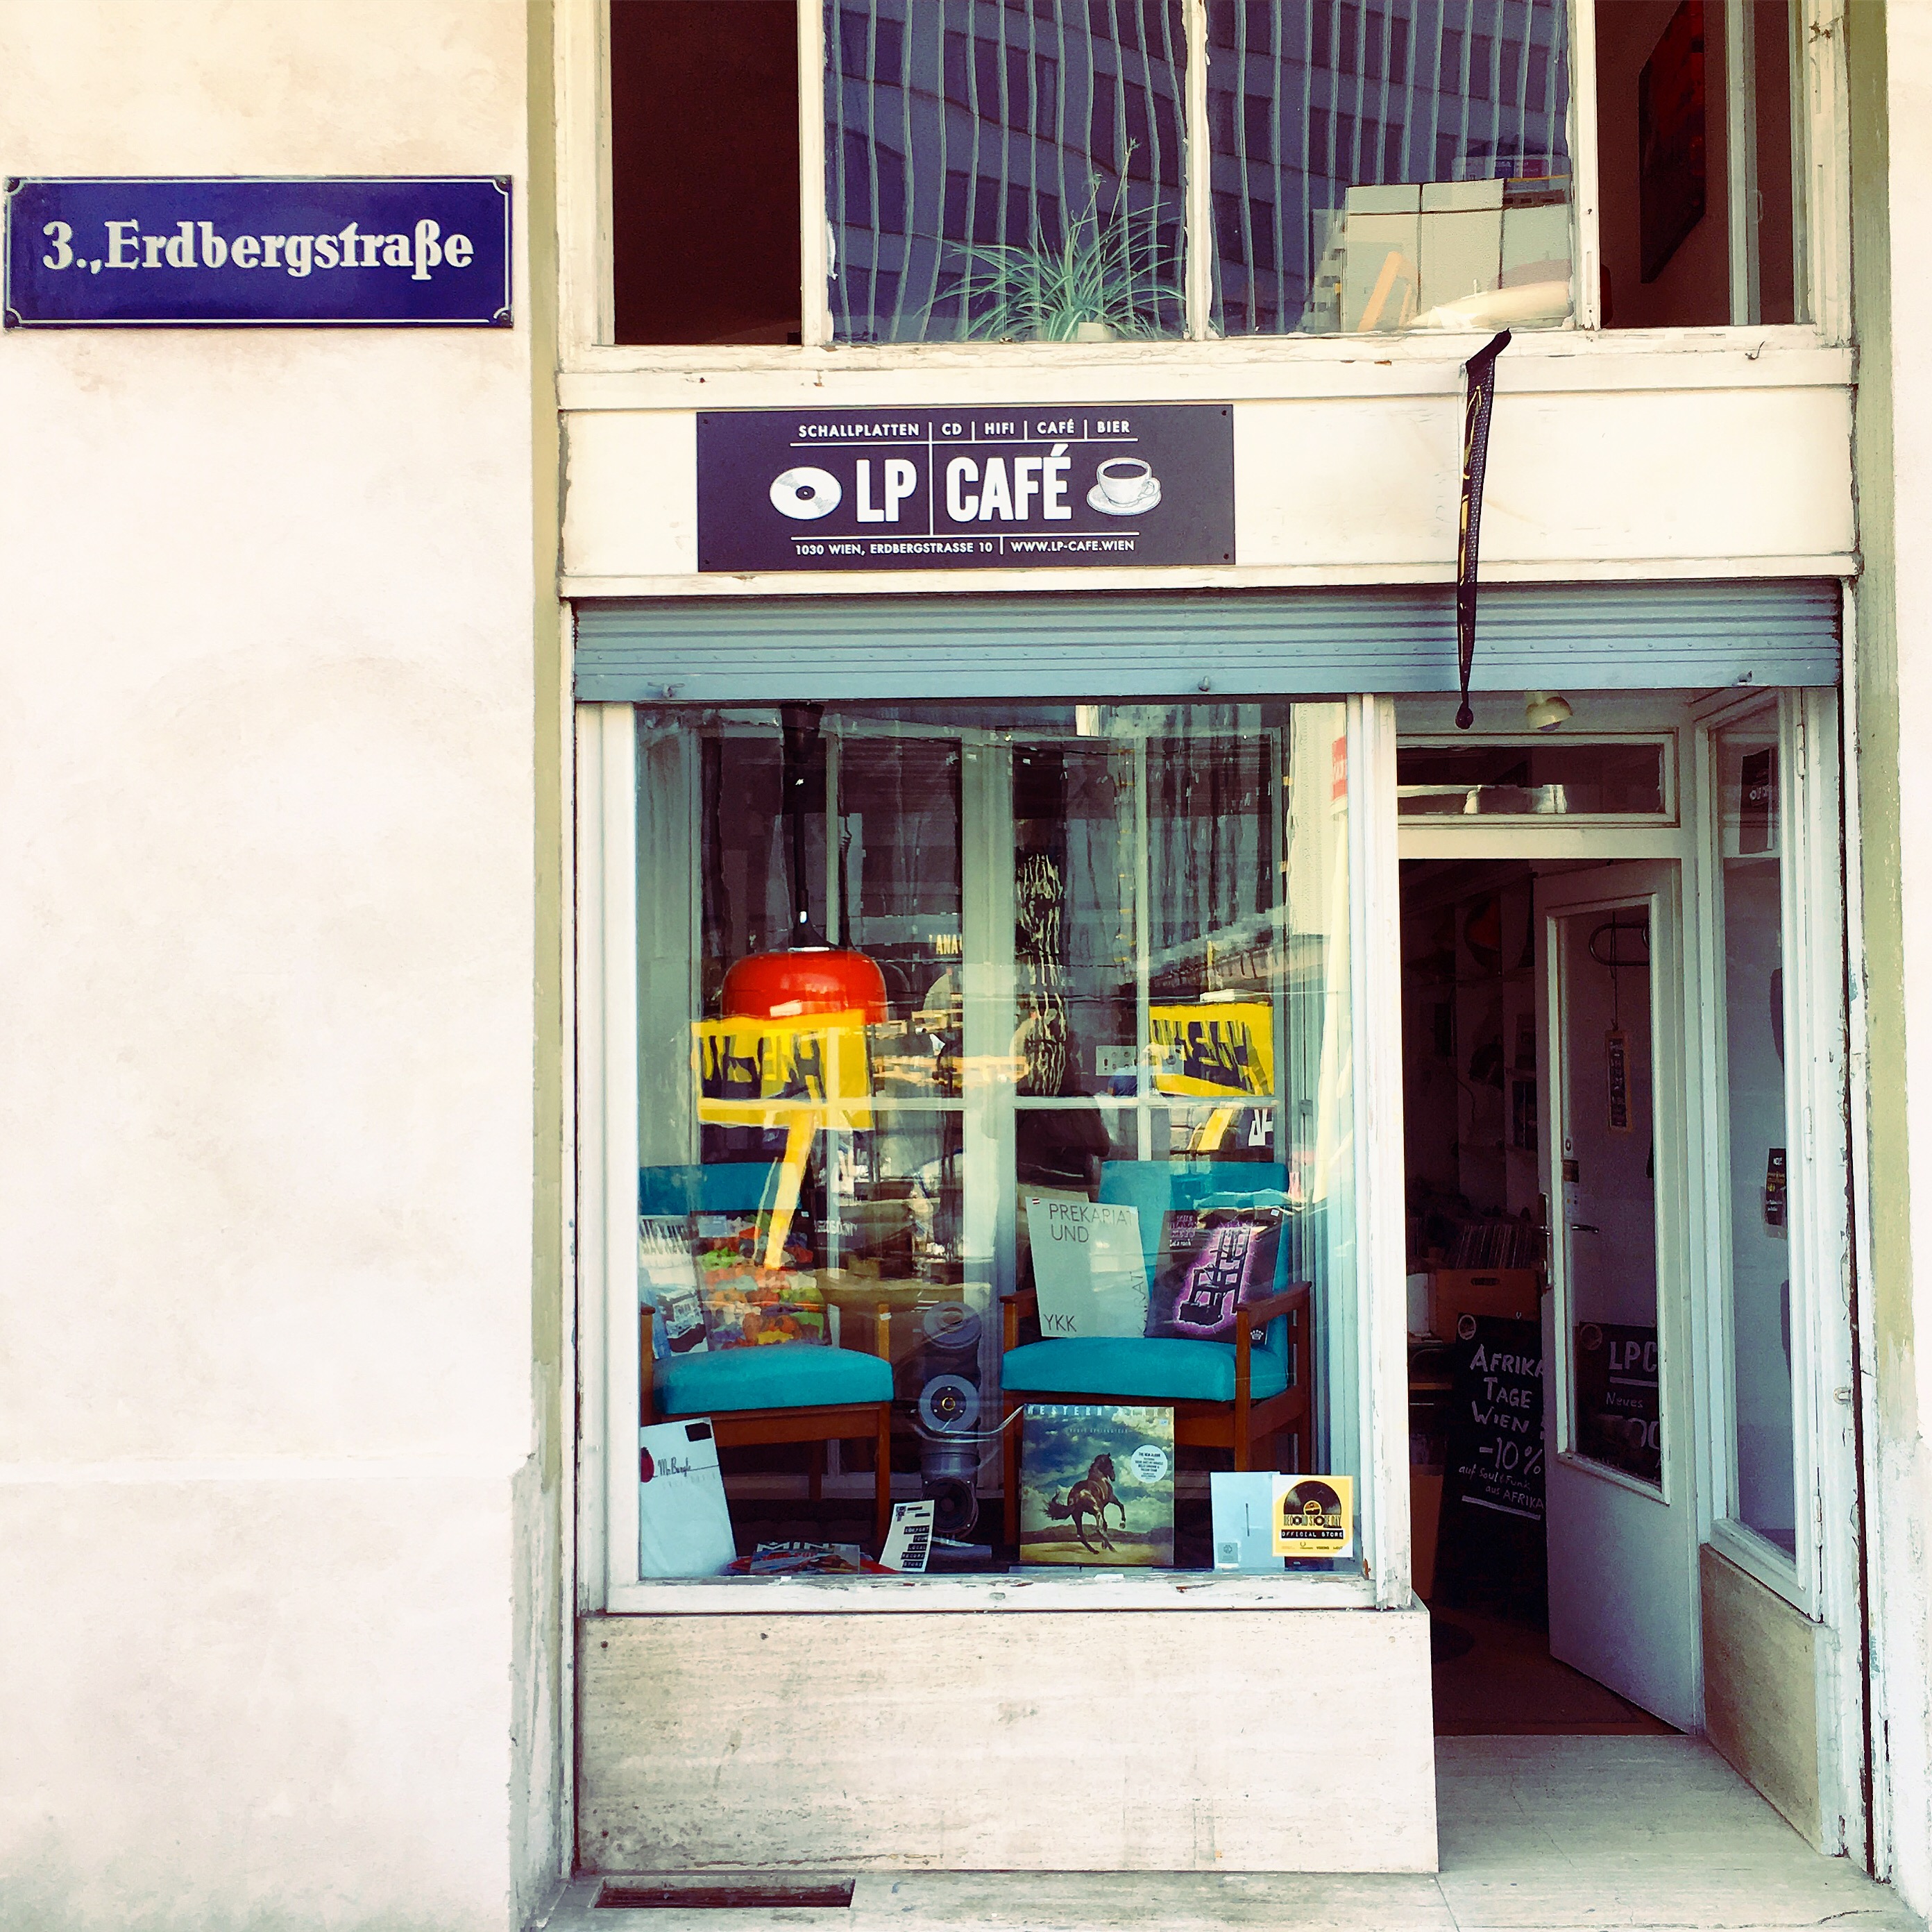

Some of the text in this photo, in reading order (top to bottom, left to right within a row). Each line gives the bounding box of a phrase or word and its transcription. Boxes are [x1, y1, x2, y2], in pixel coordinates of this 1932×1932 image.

[799, 418, 1130, 438] SCHALLPLATTEN CD HIFI CAFÉ BIER
[856, 443, 1071, 523] LP CAFÉ
[795, 540, 1135, 556] 1030 WIEN, ERDBERGSTRASSE 10 WWW.LP-CAFE.WIEN
[1049, 1203, 1133, 1226] PREKARIAT
[1051, 1224, 1090, 1243] UND
[1043, 1314, 1077, 1332] YKK
[1483, 1377, 1532, 1409] TAGE
[1606, 1391, 1643, 1409] Neues
[1026, 1405, 1103, 1416] WESTERN
[1471, 1400, 1530, 1434] WIEN
[1502, 1489, 1544, 1509] AFRIKA
